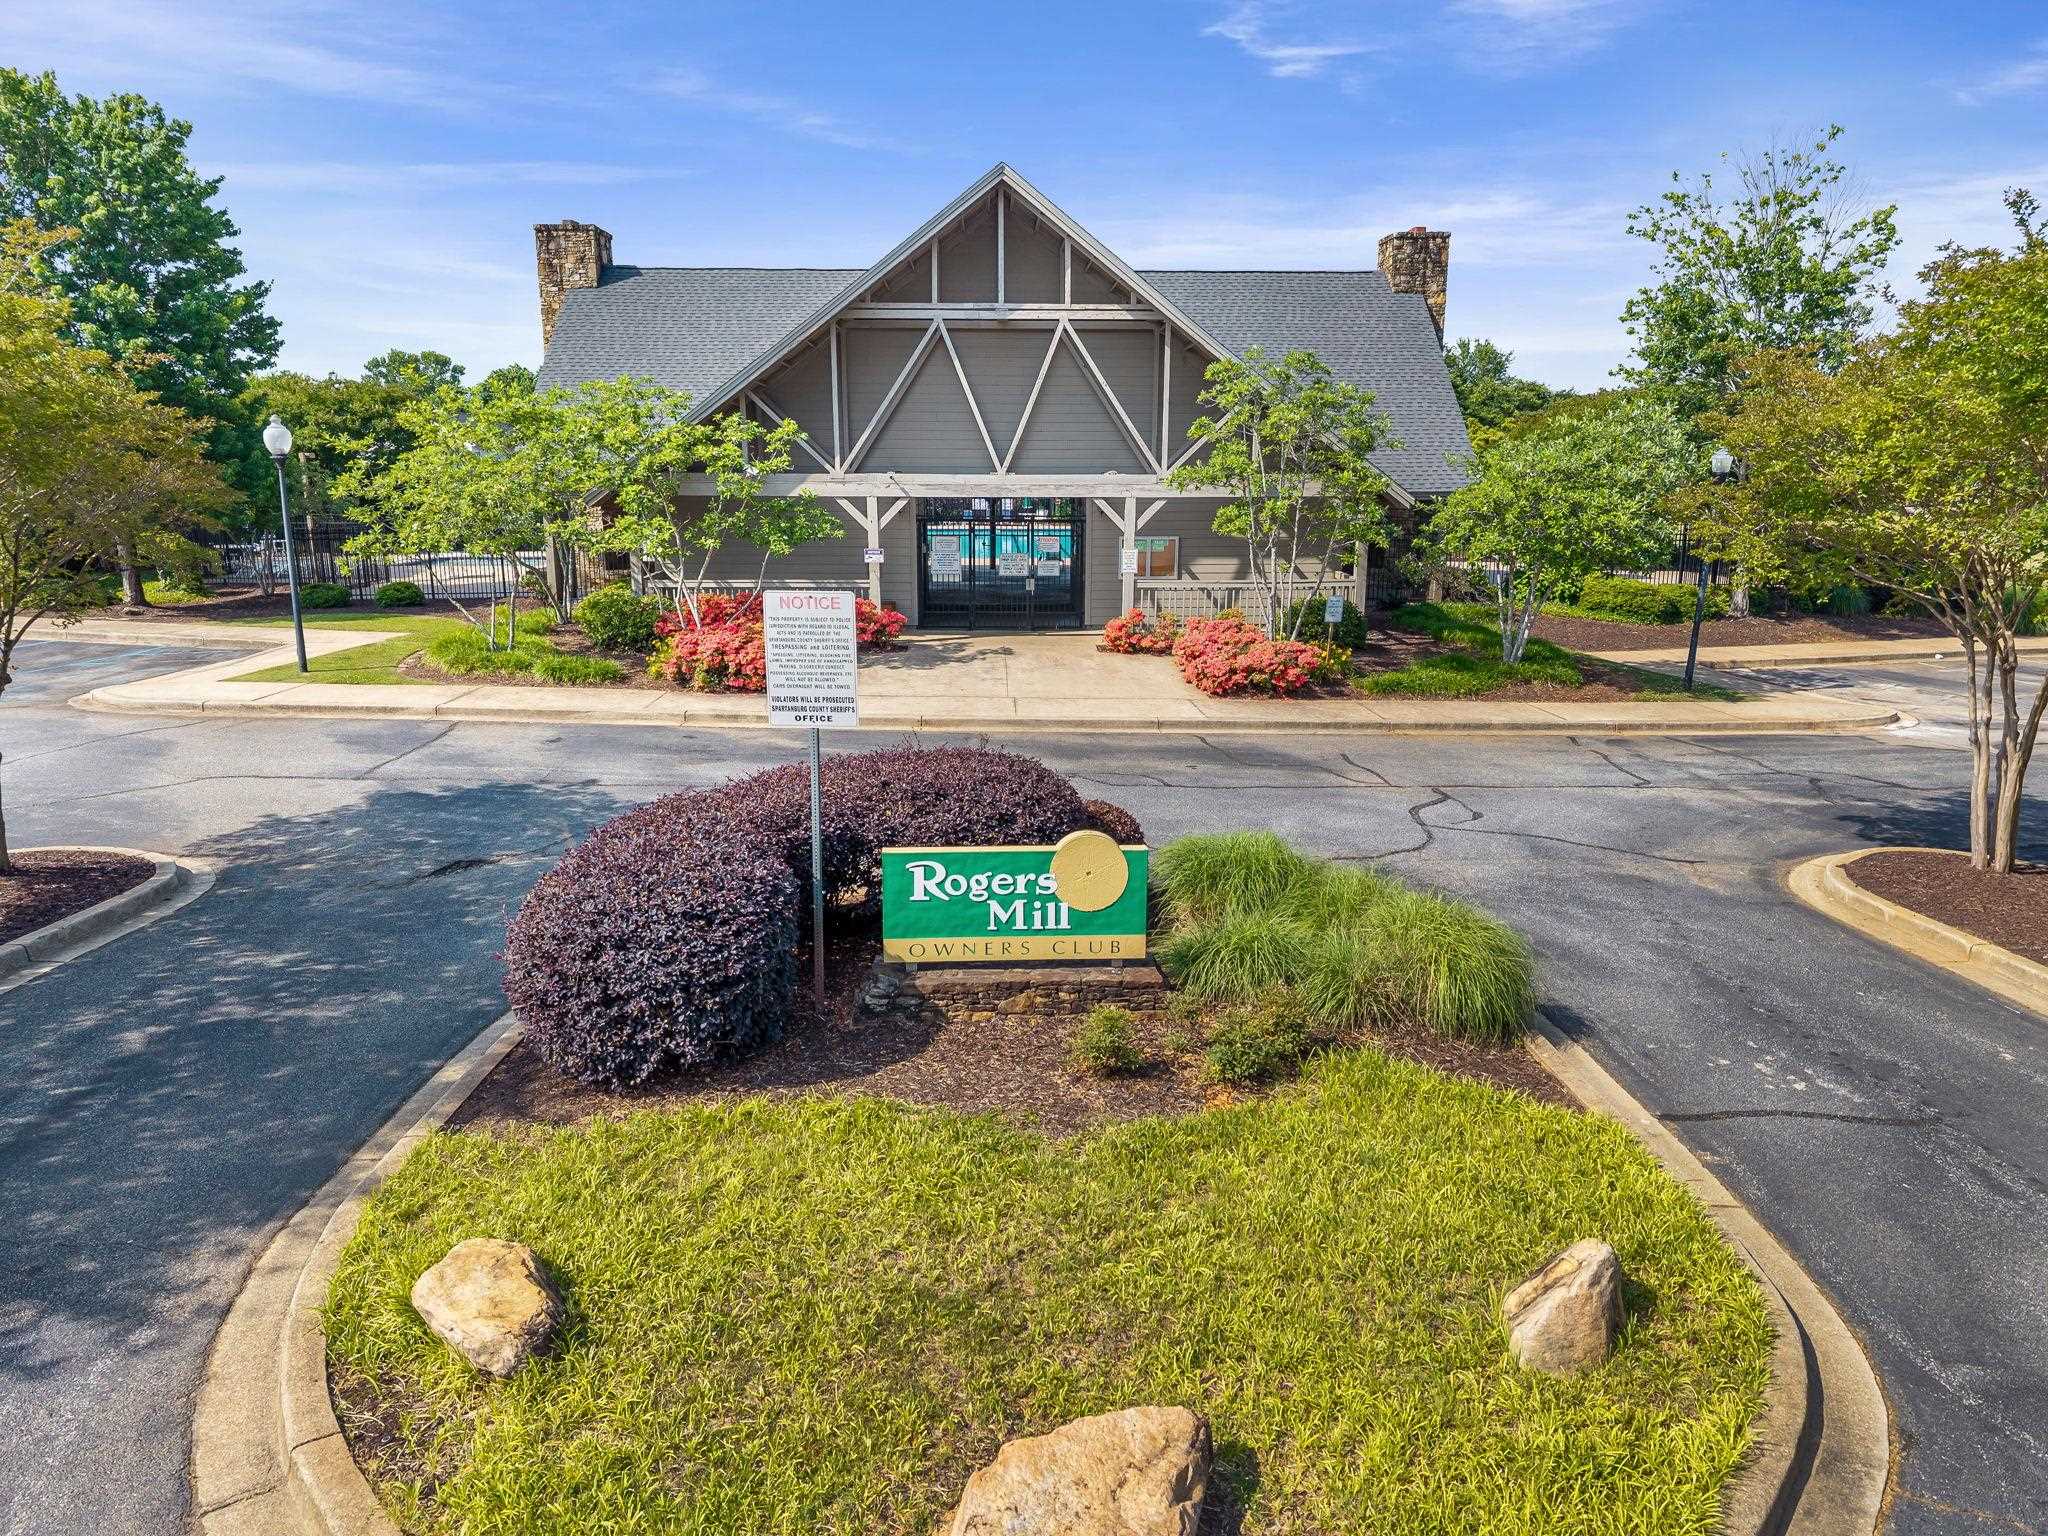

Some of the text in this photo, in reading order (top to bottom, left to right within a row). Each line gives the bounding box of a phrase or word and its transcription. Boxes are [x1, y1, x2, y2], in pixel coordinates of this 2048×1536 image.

[780, 596, 840, 610] NOTICE
[906, 861, 1058, 901] Rogers
[987, 900, 1071, 930] Mill
[909, 940, 1120, 957] OWNERS CLUB
